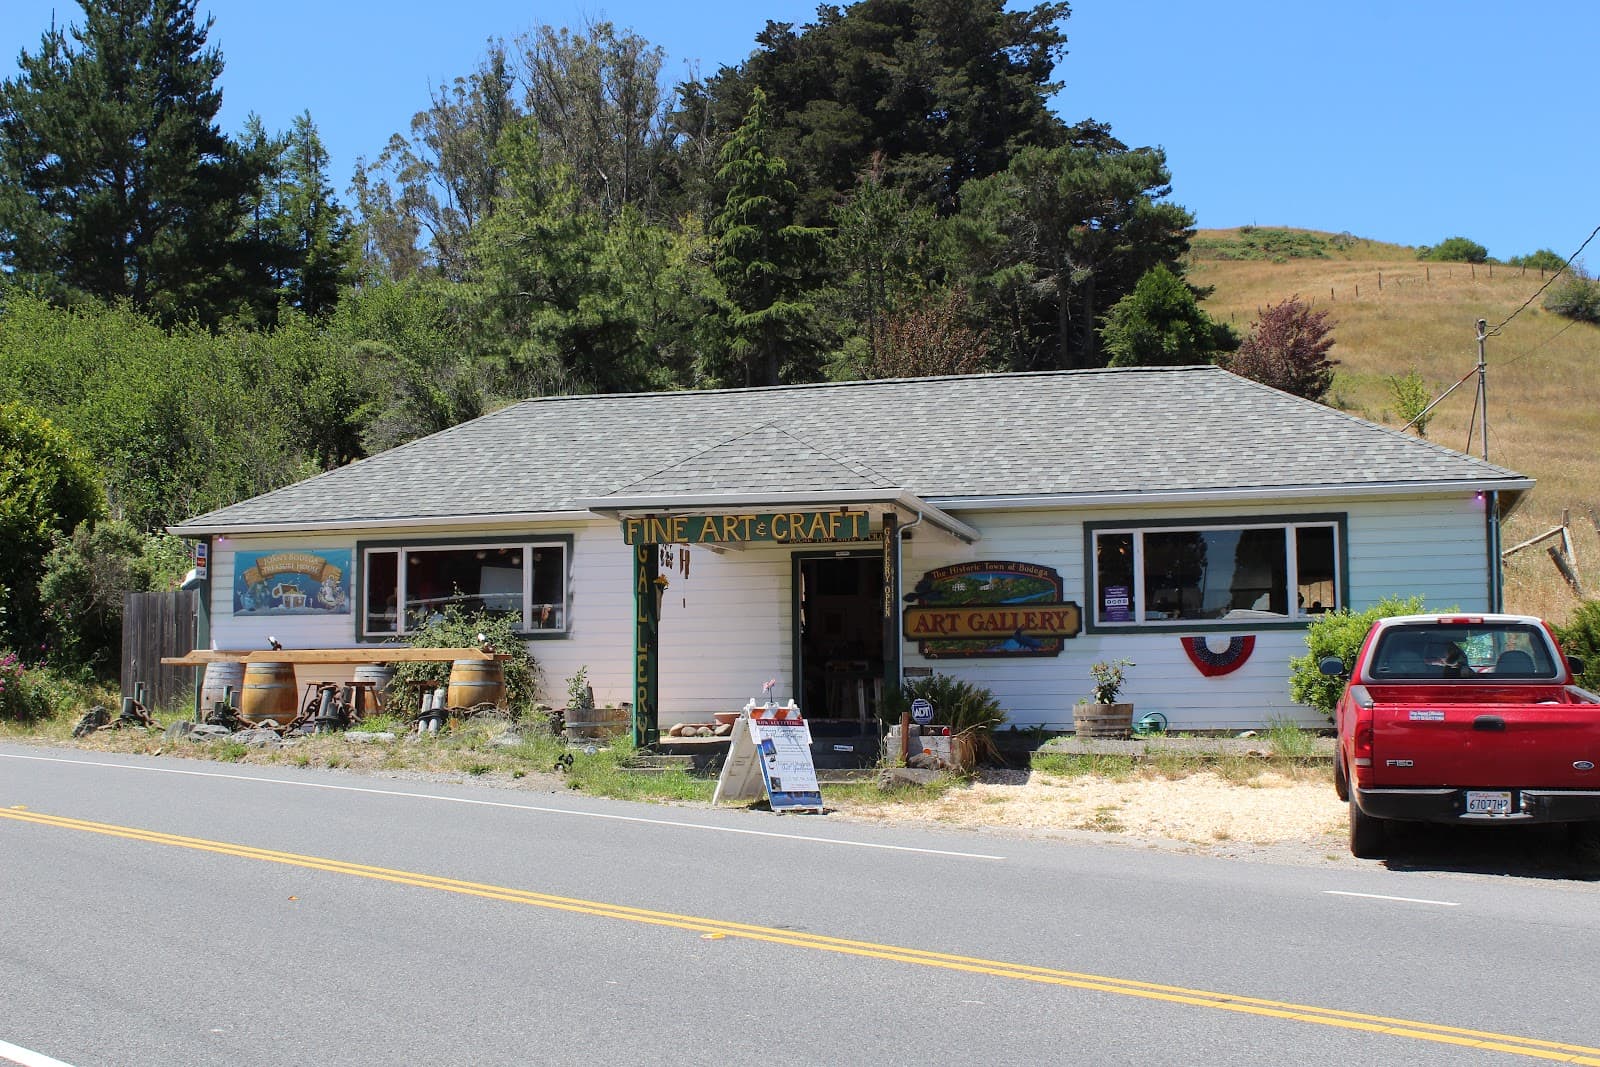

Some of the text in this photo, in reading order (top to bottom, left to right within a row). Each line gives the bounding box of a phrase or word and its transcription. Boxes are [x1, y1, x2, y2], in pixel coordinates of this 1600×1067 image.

[627, 511, 865, 544] FINE ART & CRAFT
[884, 527, 892, 617] GALLERY OPEN
[931, 562, 1048, 579] The Historic Town of Bodega
[913, 610, 1070, 635] ART GALLERY
[637, 544, 648, 744] GALLERY
[914, 706, 929, 718] ADT
